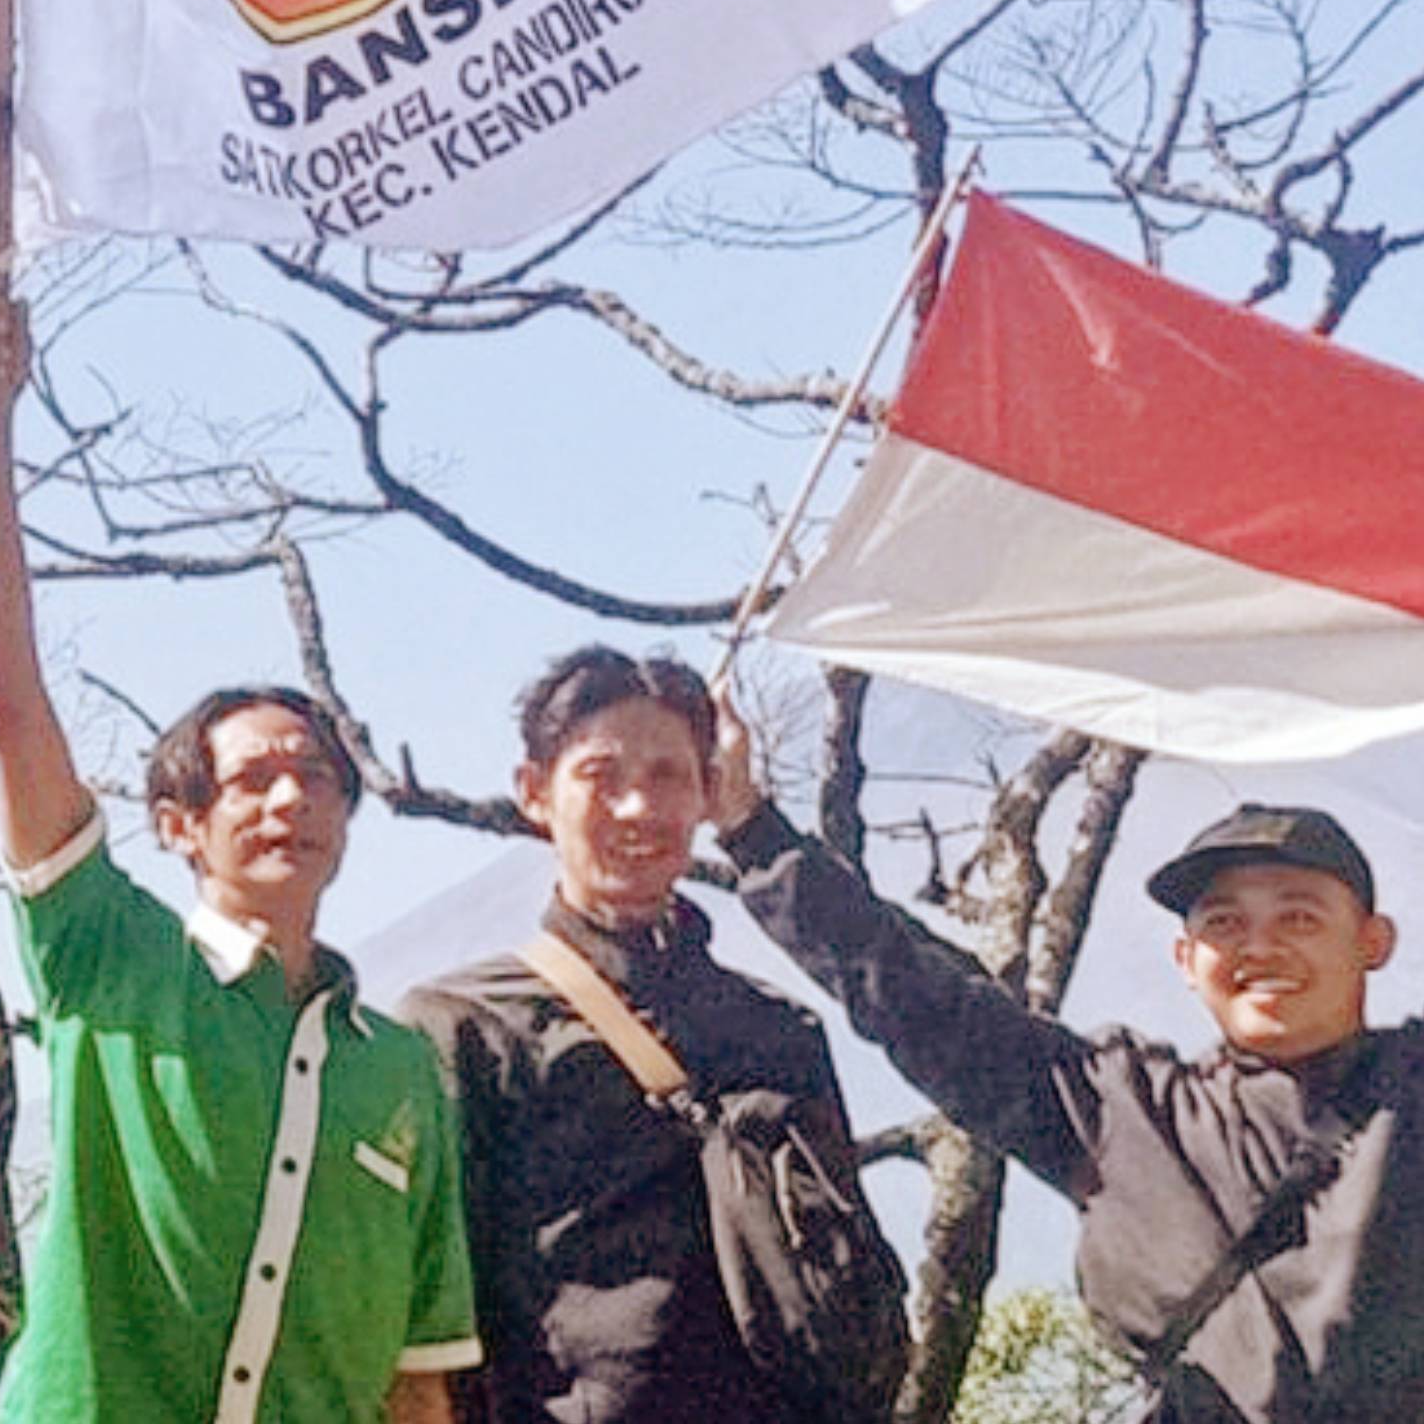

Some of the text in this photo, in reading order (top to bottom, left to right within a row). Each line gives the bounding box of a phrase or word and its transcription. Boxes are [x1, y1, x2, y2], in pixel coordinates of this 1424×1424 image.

[220, 86, 453, 201] SATKORKEL
[304, 45, 642, 241] KEC. KENDAL
